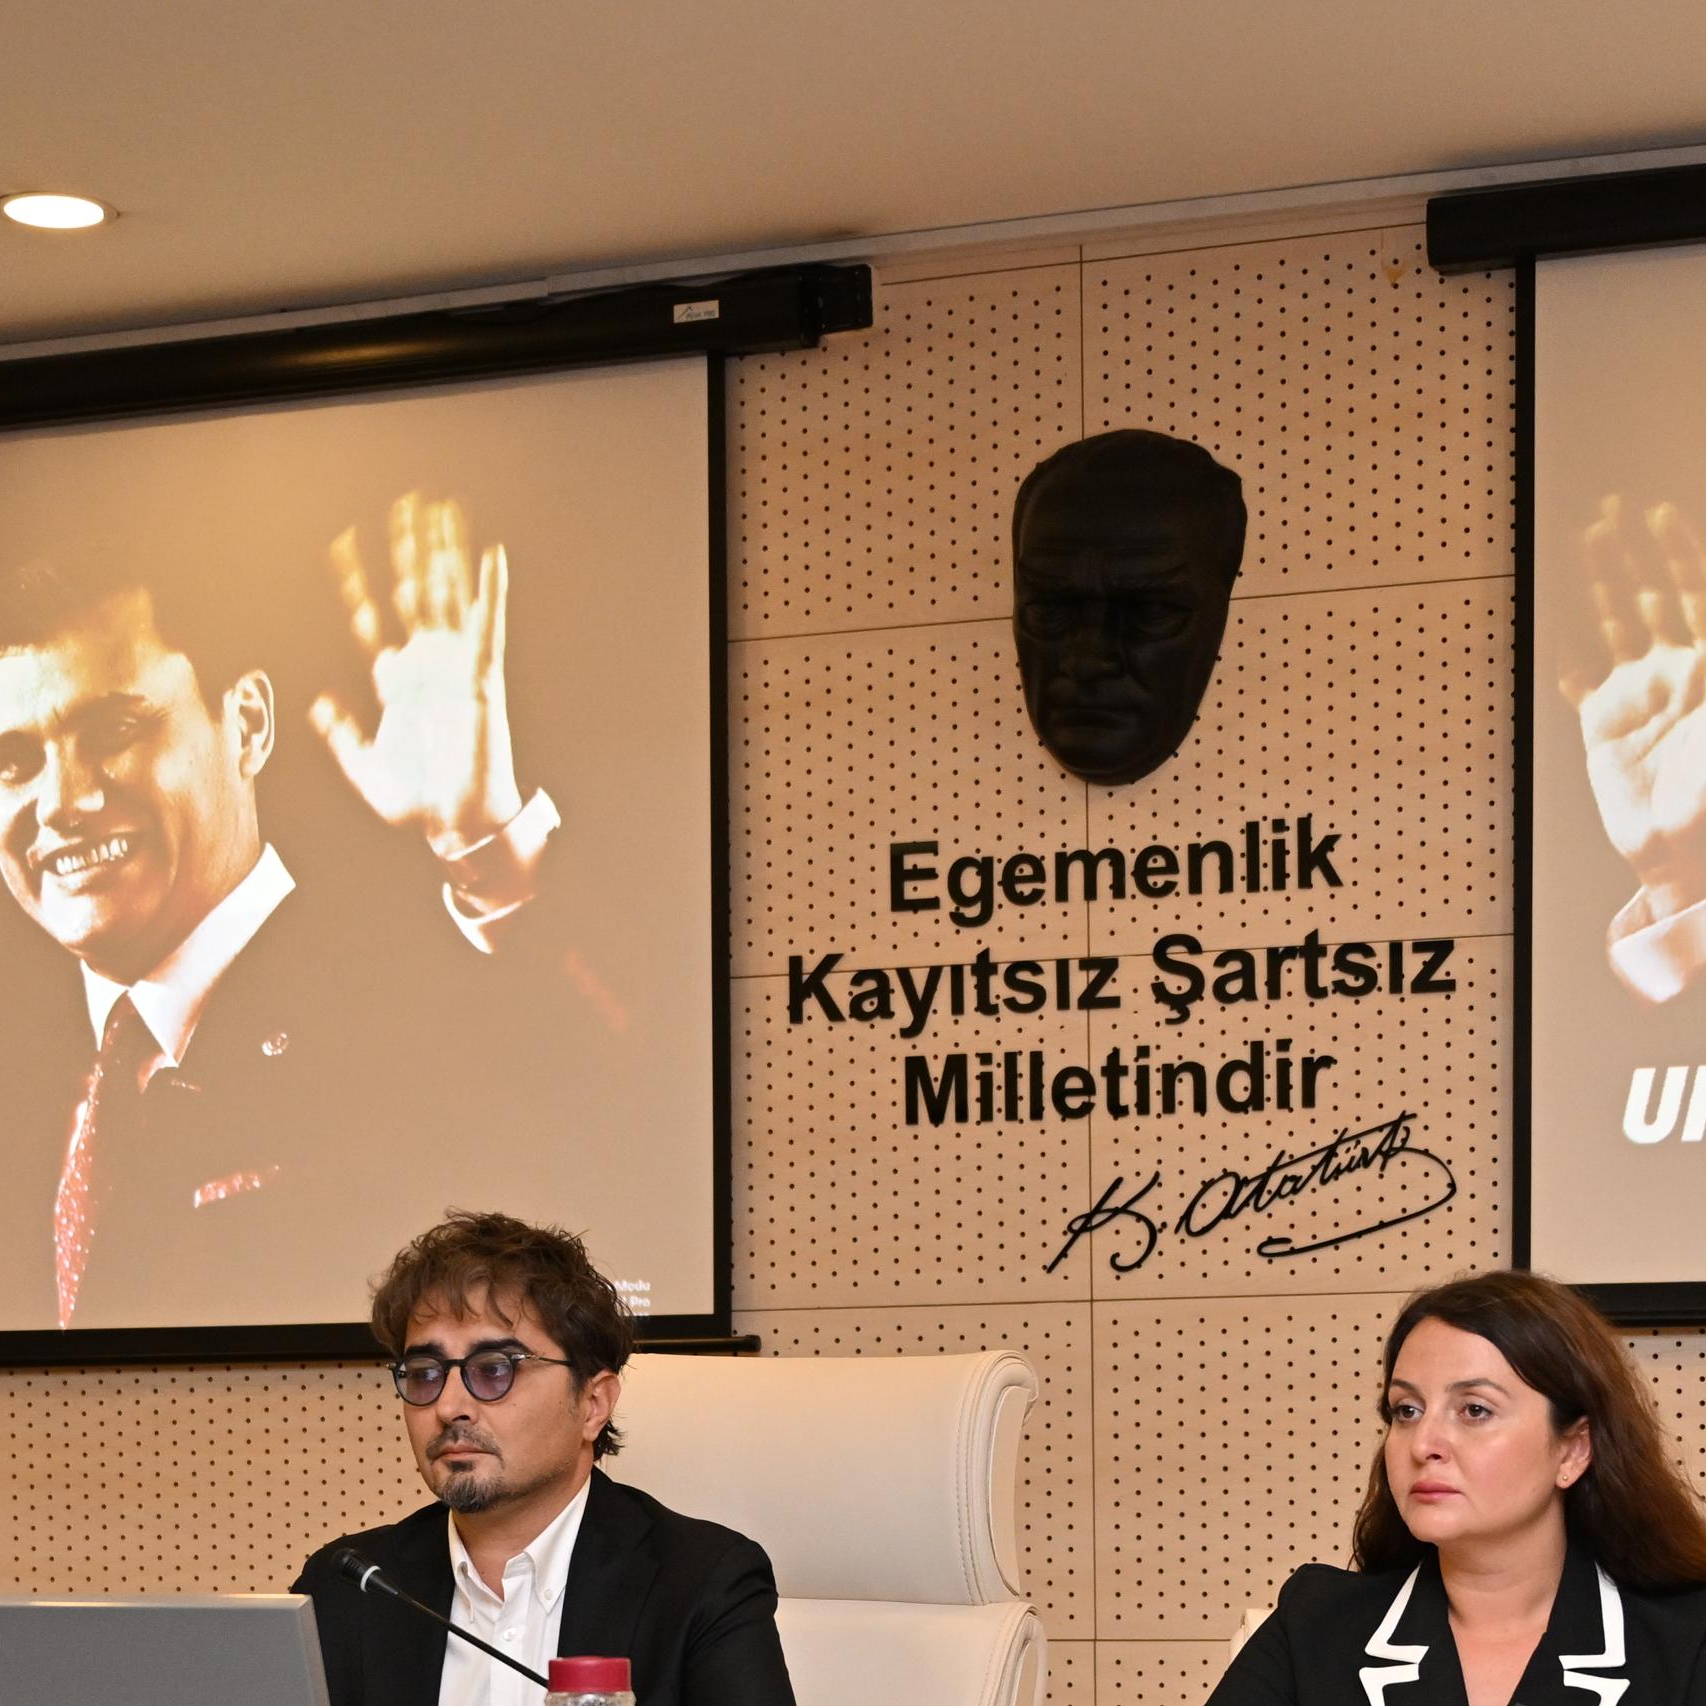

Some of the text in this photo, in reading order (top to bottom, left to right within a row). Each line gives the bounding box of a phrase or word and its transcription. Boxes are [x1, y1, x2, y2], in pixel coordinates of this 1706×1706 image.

[890, 813, 1343, 928] Egemenlik
[787, 928, 1457, 1039] Kayıtsız Şartsız
[904, 1038, 1338, 1128] Milletindir
